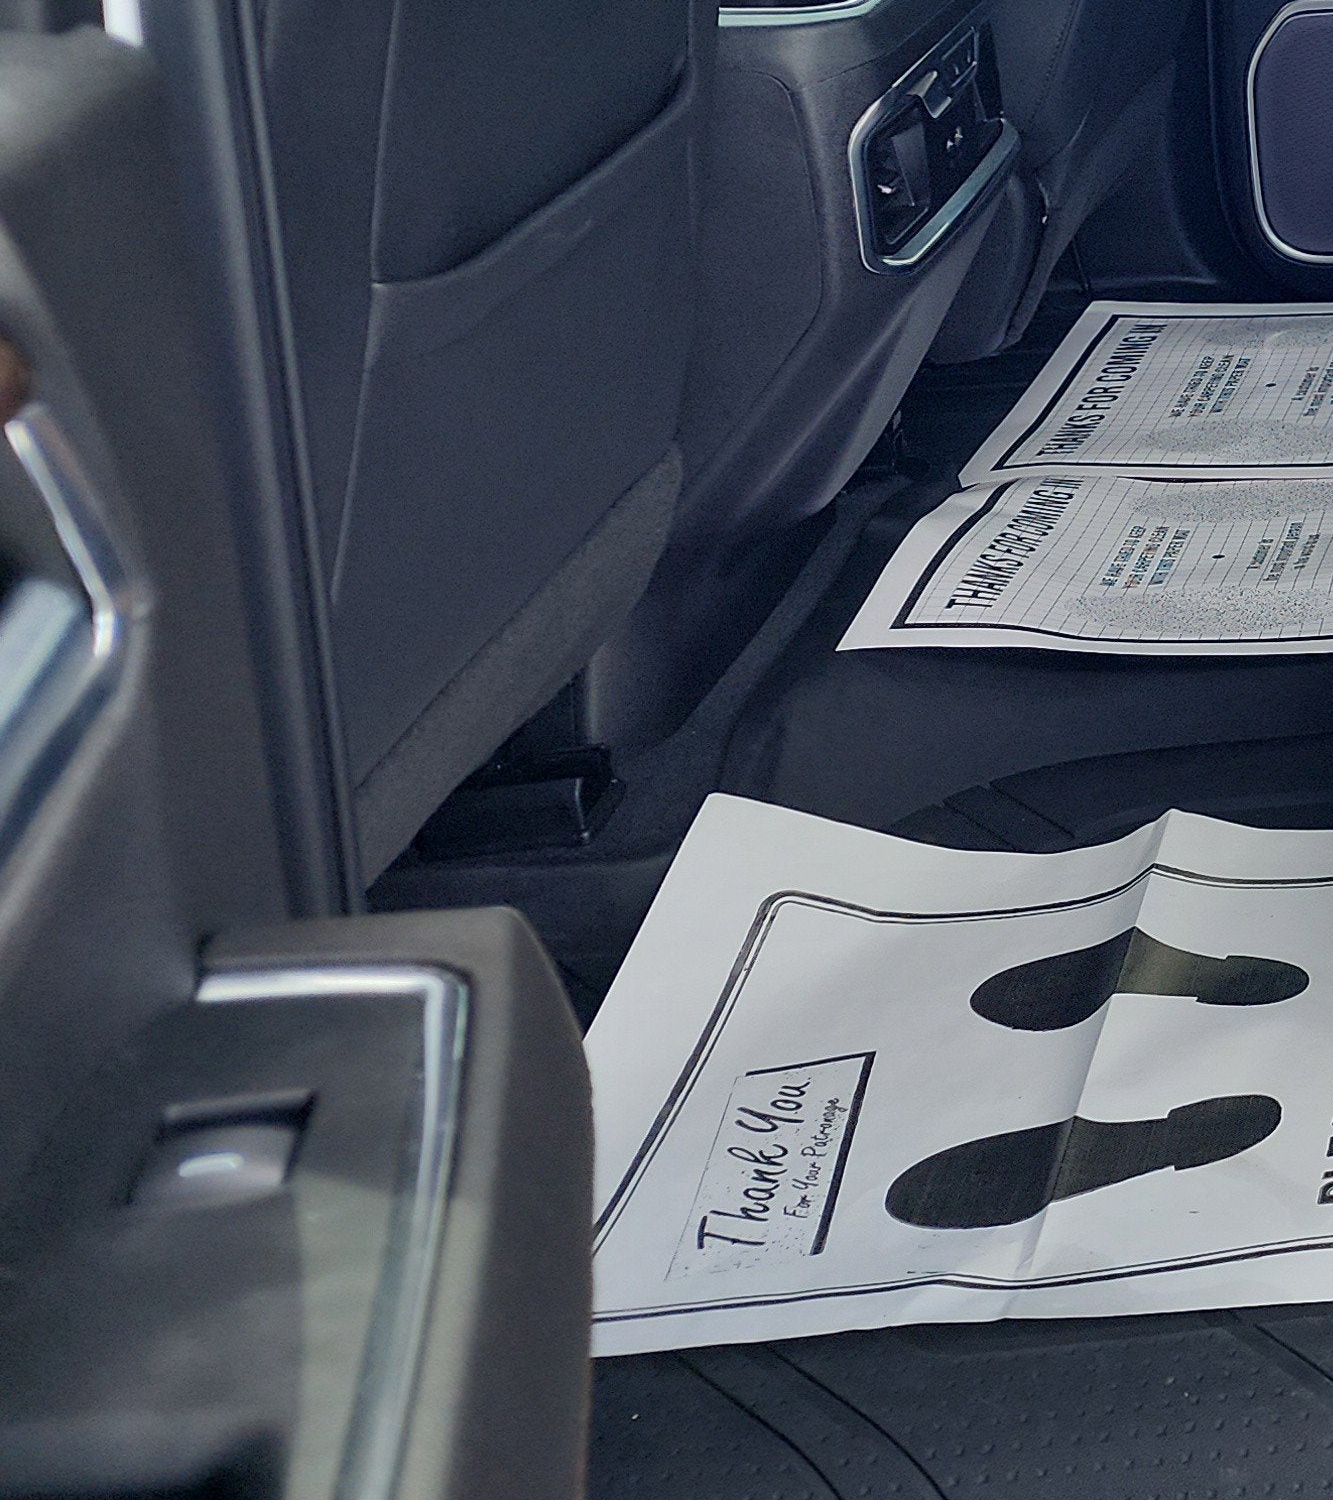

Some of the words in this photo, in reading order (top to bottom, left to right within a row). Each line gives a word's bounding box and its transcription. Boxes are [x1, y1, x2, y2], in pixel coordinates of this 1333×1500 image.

[1096, 335, 1157, 382] COMING
[1076, 385, 1125, 410] FOR
[1036, 414, 1105, 456] THANKS
[1040, 478, 1085, 489] IN
[1007, 489, 1075, 536] COMING
[989, 532, 1043, 558] FOR
[945, 553, 1024, 609] THANKS
[801, 1097, 849, 1157] Patronage
[698, 1143, 789, 1250] Thank
[792, 1161, 822, 1192] Your
[783, 1194, 812, 1219] For
